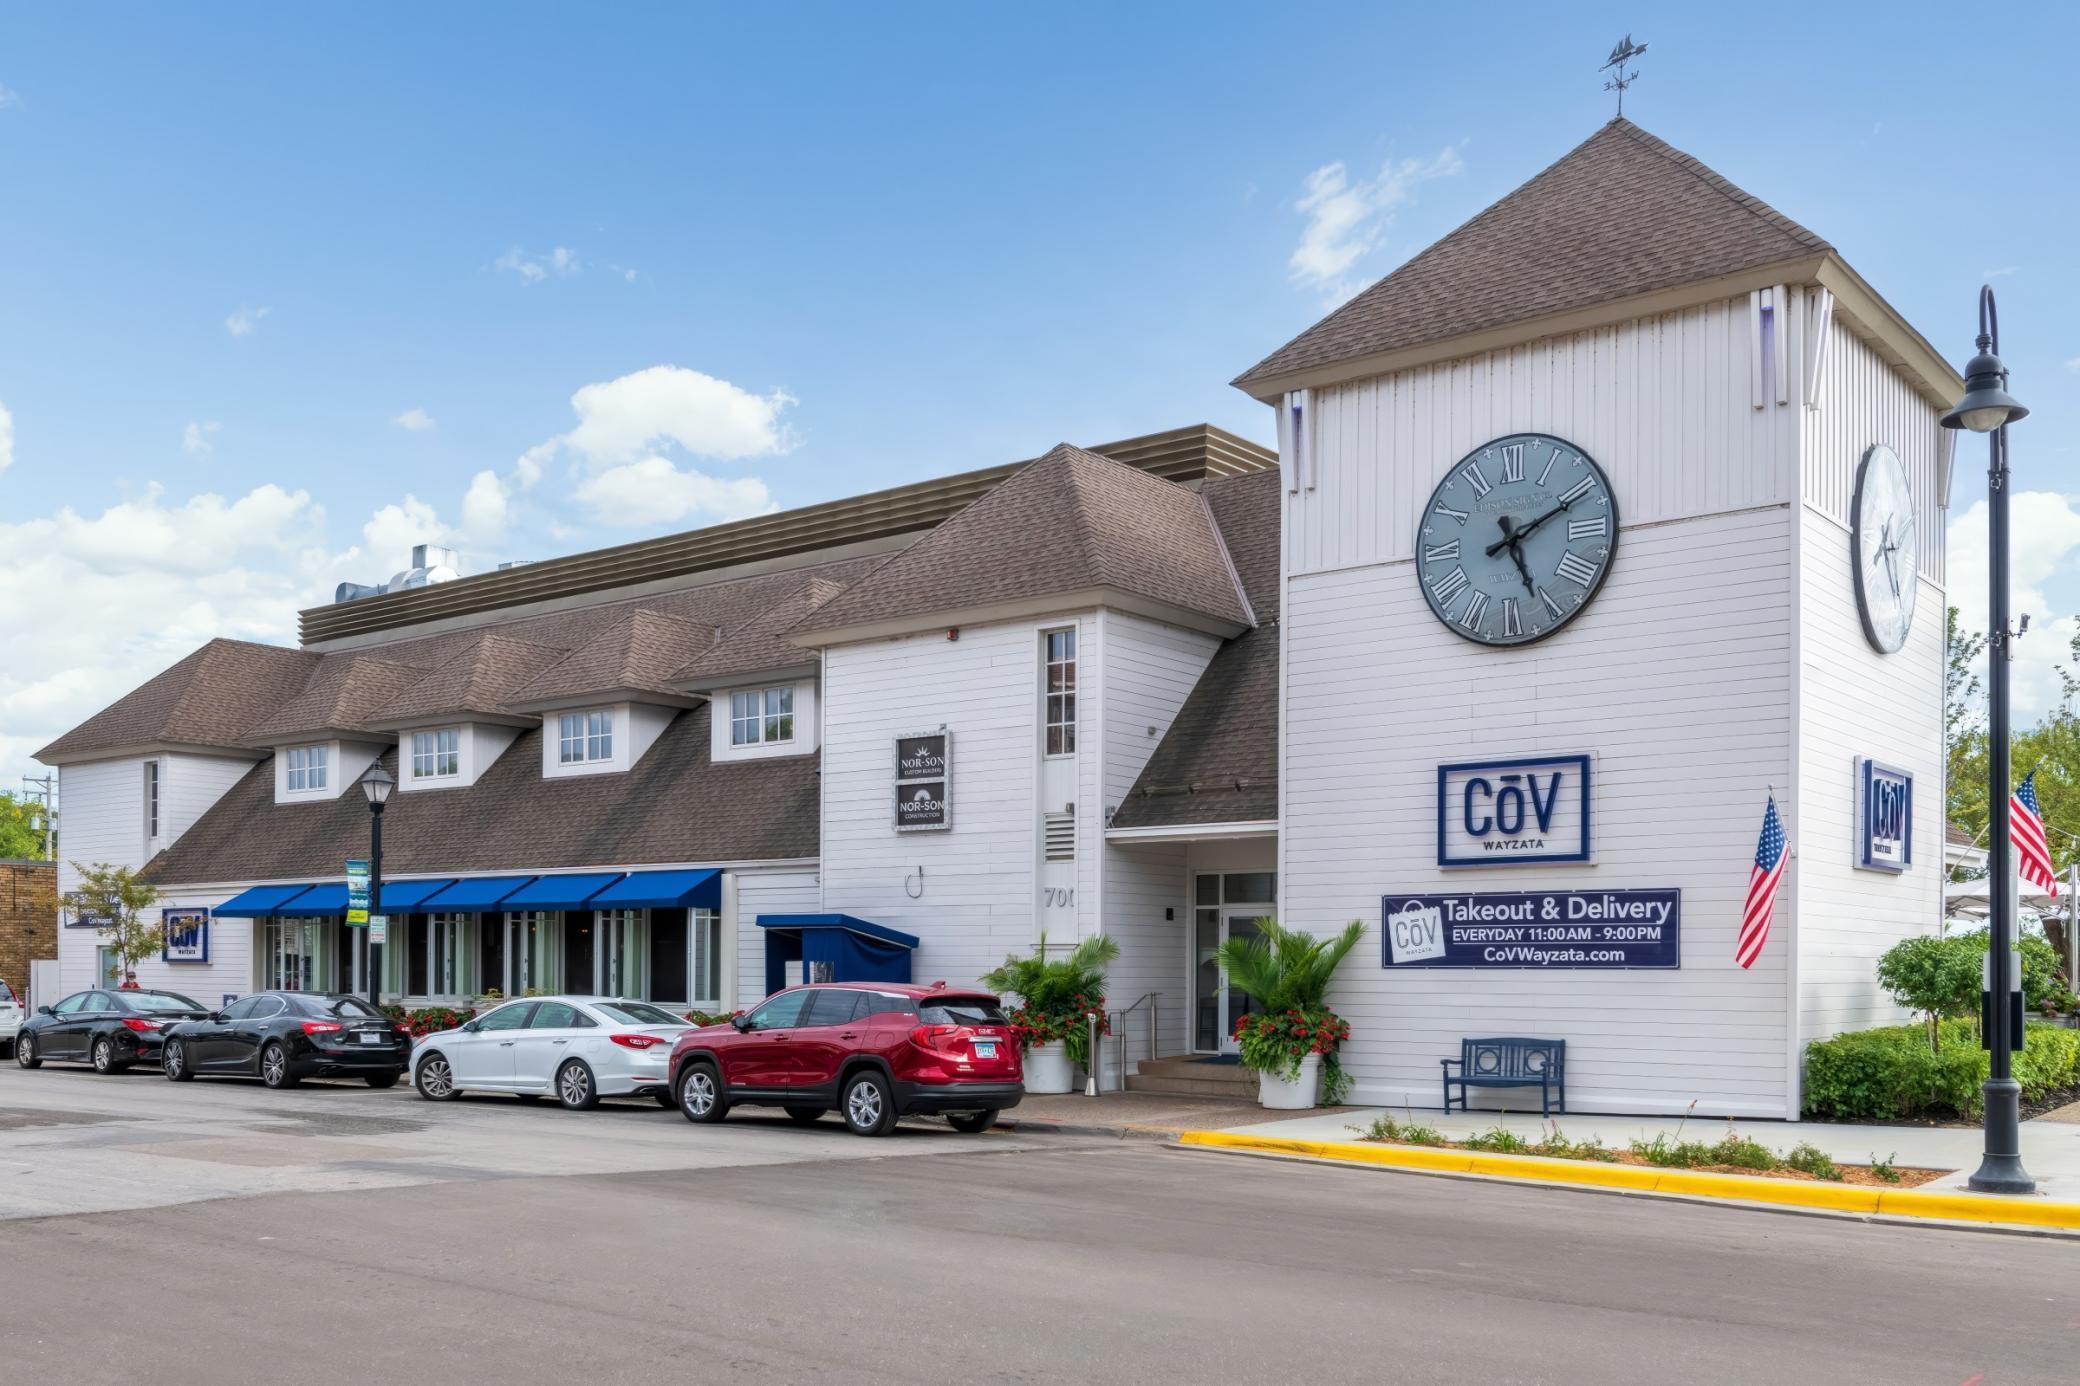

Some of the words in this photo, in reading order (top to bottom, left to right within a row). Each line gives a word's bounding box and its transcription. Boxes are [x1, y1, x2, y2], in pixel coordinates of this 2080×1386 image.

[1500, 443, 1525, 484] XII
[1536, 448, 1562, 487] I
[1461, 460, 1493, 500] XI
[1434, 501, 1470, 527] X
[1568, 516, 1608, 542] III
[1555, 550, 1600, 588] IIII
[1430, 565, 1471, 610] VIII
[1458, 590, 1491, 633] VII
[1503, 597, 1523, 637] VI
[1538, 586, 1565, 621] V
[901, 755, 945, 769] NOR-SON
[900, 800, 945, 813] NOR-SON
[904, 812, 940, 820] CONSTRUCTION
[1483, 838, 1545, 851] WAYZATA
[1443, 897, 1535, 922] Takeout
[1542, 896, 1560, 920] &
[1568, 894, 1672, 924] Delivery
[1452, 928, 1524, 942] EVERYDAY
[1484, 946, 1625, 965] CoVWayzata.com
